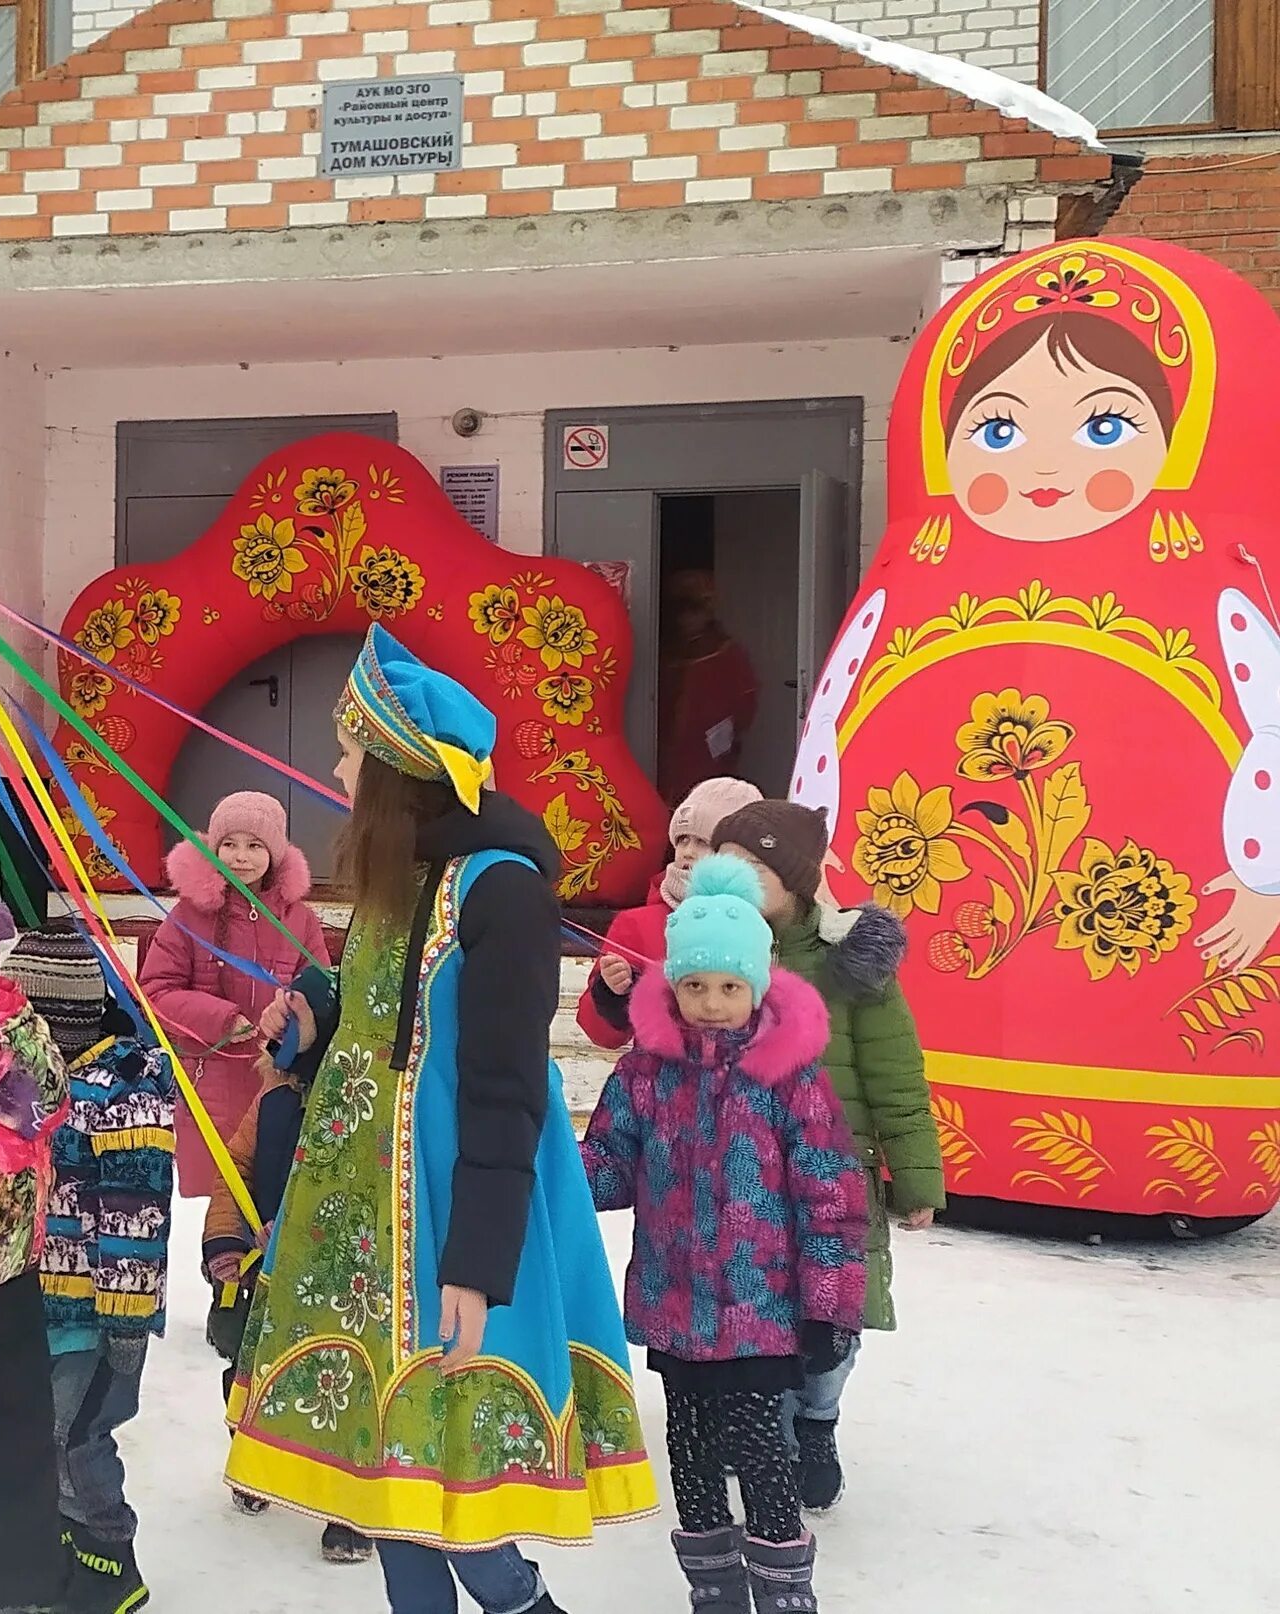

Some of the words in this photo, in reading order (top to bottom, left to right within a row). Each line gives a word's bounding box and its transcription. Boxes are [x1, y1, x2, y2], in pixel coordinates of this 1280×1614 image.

[356, 87, 380, 98] АУК
[384, 85, 404, 96] МО
[406, 83, 431, 95] ЗГО
[411, 97, 449, 108] центр
[334, 113, 391, 127] культуры
[394, 113, 402, 121] и
[331, 131, 454, 153] ТУМАШОВСКИЙ
[330, 157, 366, 172] ДОМ
[370, 151, 452, 166] КУЛЬТУРЫ
